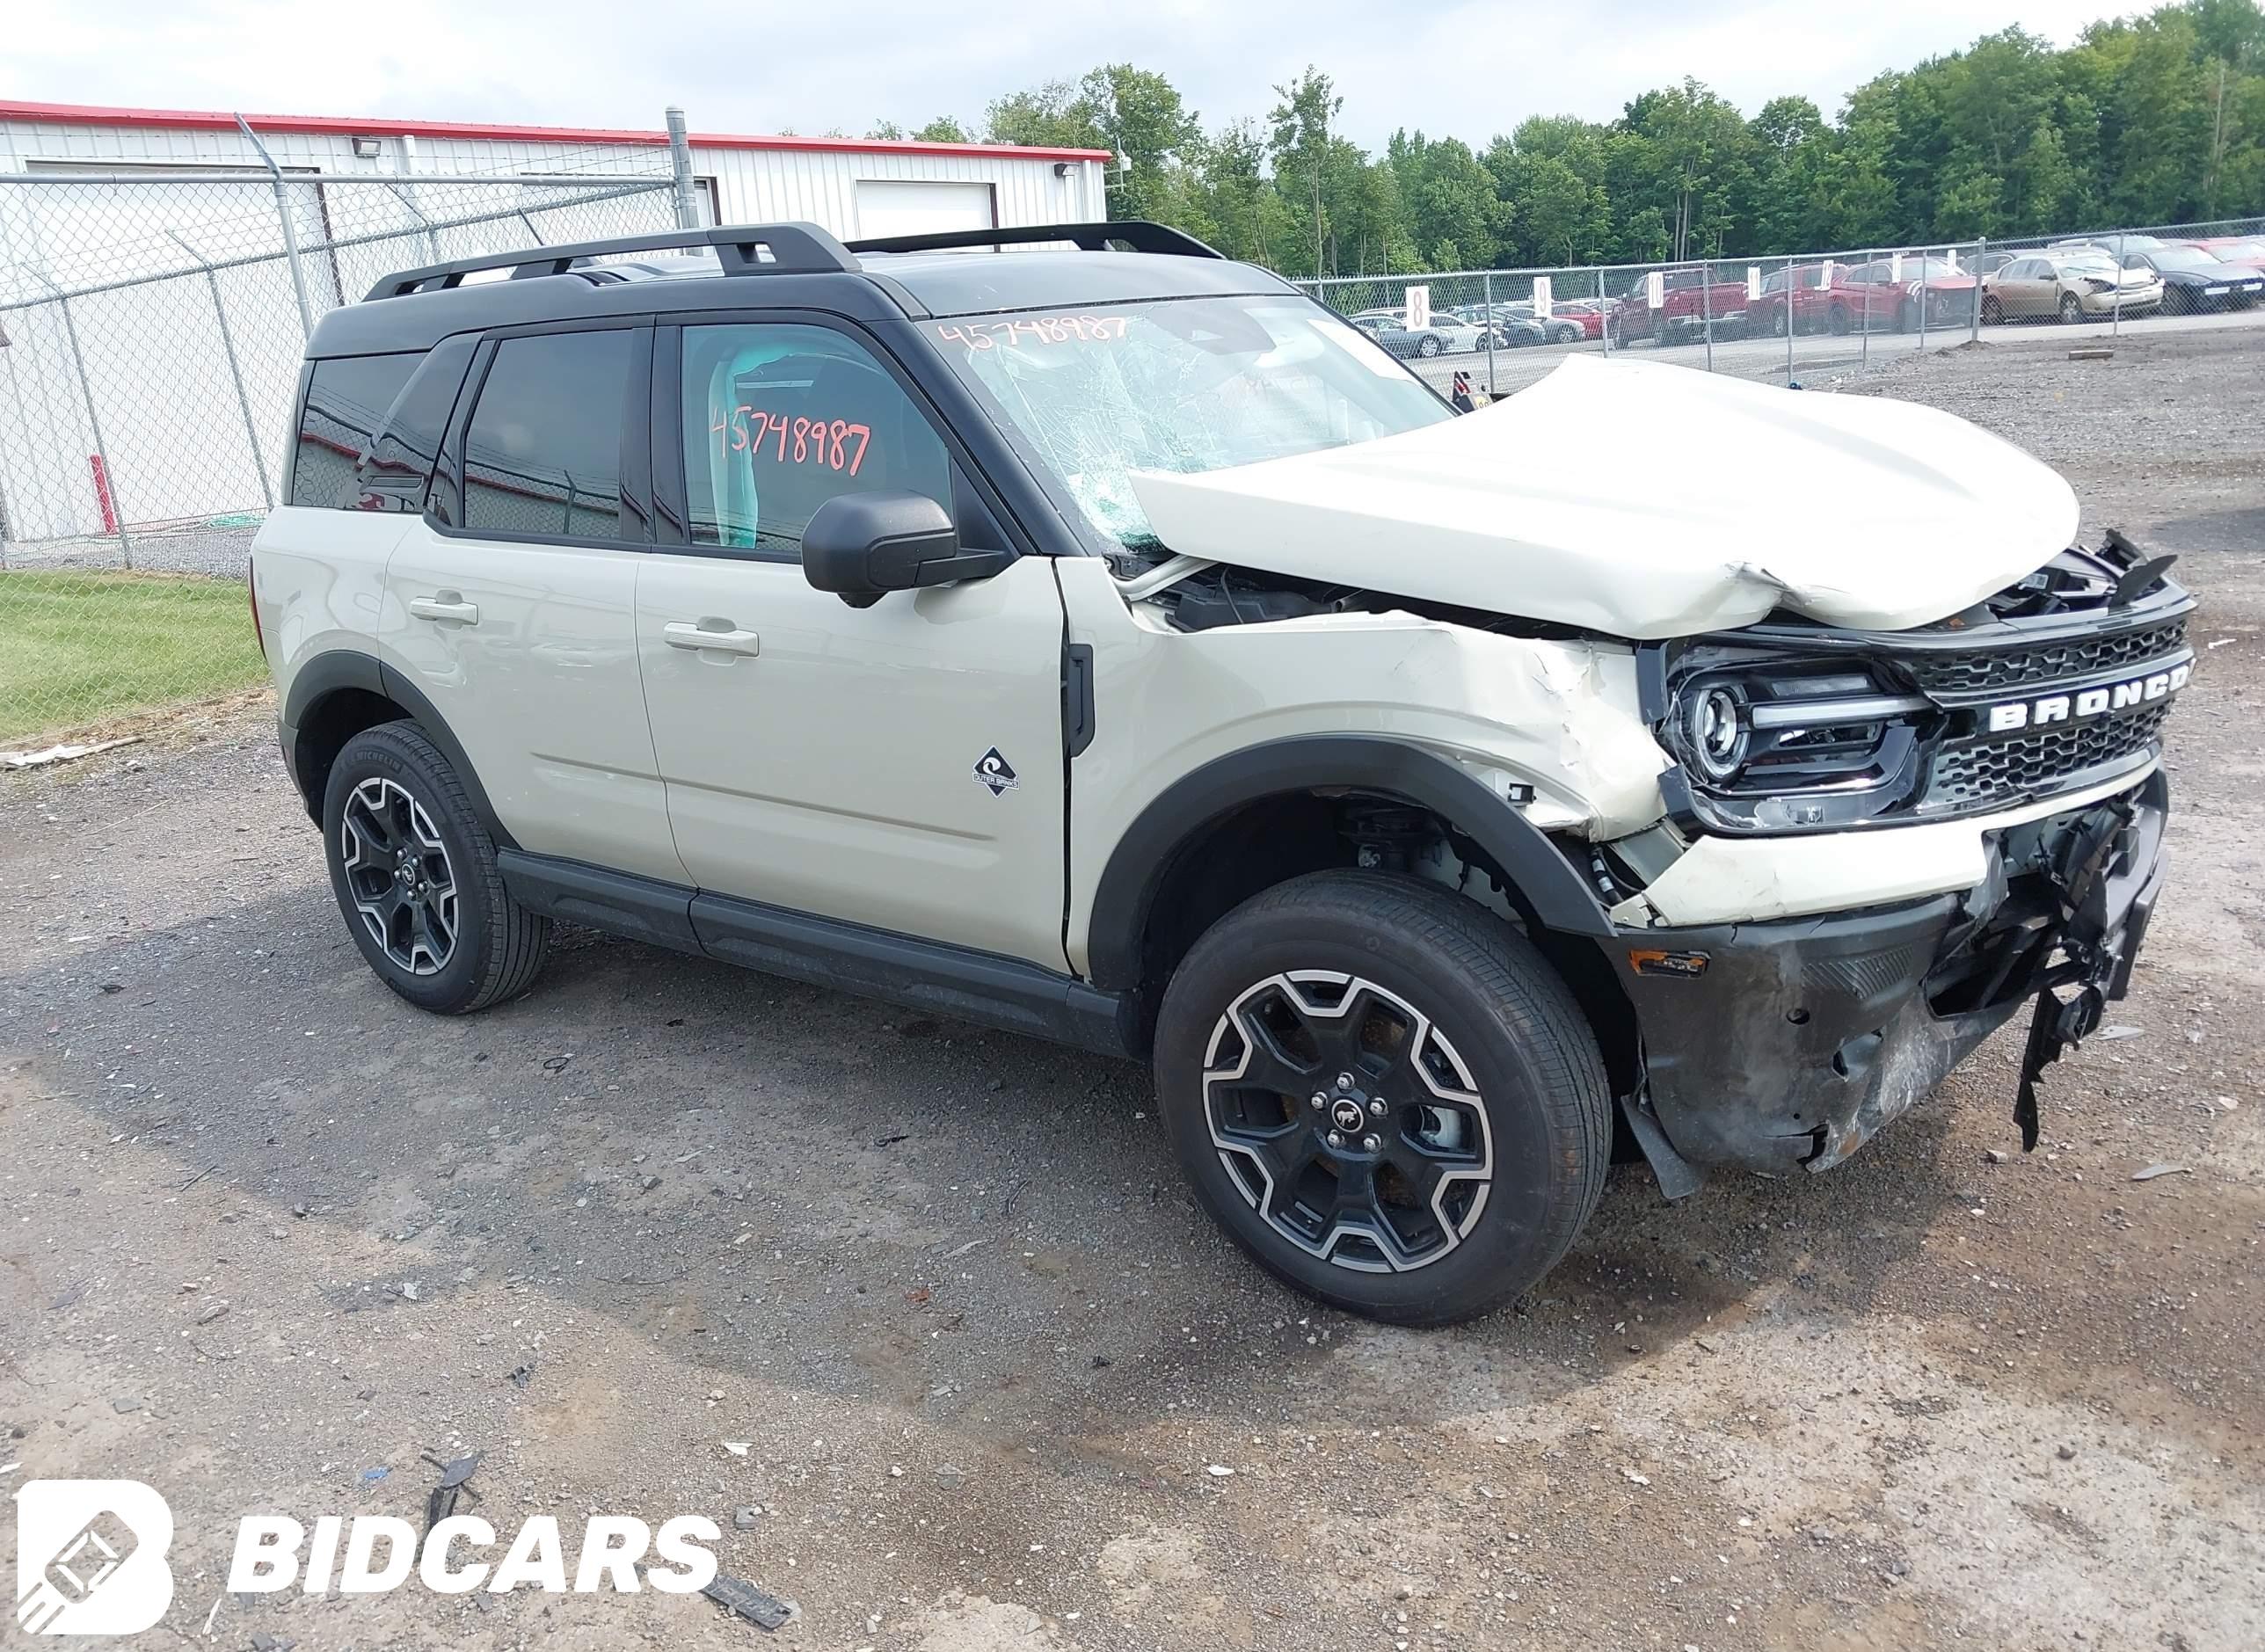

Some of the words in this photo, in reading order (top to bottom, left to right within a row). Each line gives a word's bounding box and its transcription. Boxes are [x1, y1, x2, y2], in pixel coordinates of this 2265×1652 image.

[1538, 280, 1547, 313] 9
[1650, 275, 1663, 304] 10
[1413, 290, 1424, 327] 8
[937, 315, 1126, 350] 45748987
[710, 405, 870, 477] 45748987
[1989, 665, 2189, 732] BRONCO
[357, 751, 401, 772] MICHELIN
[974, 775, 995, 783] OUTER
[995, 778, 1018, 788] BANKS
